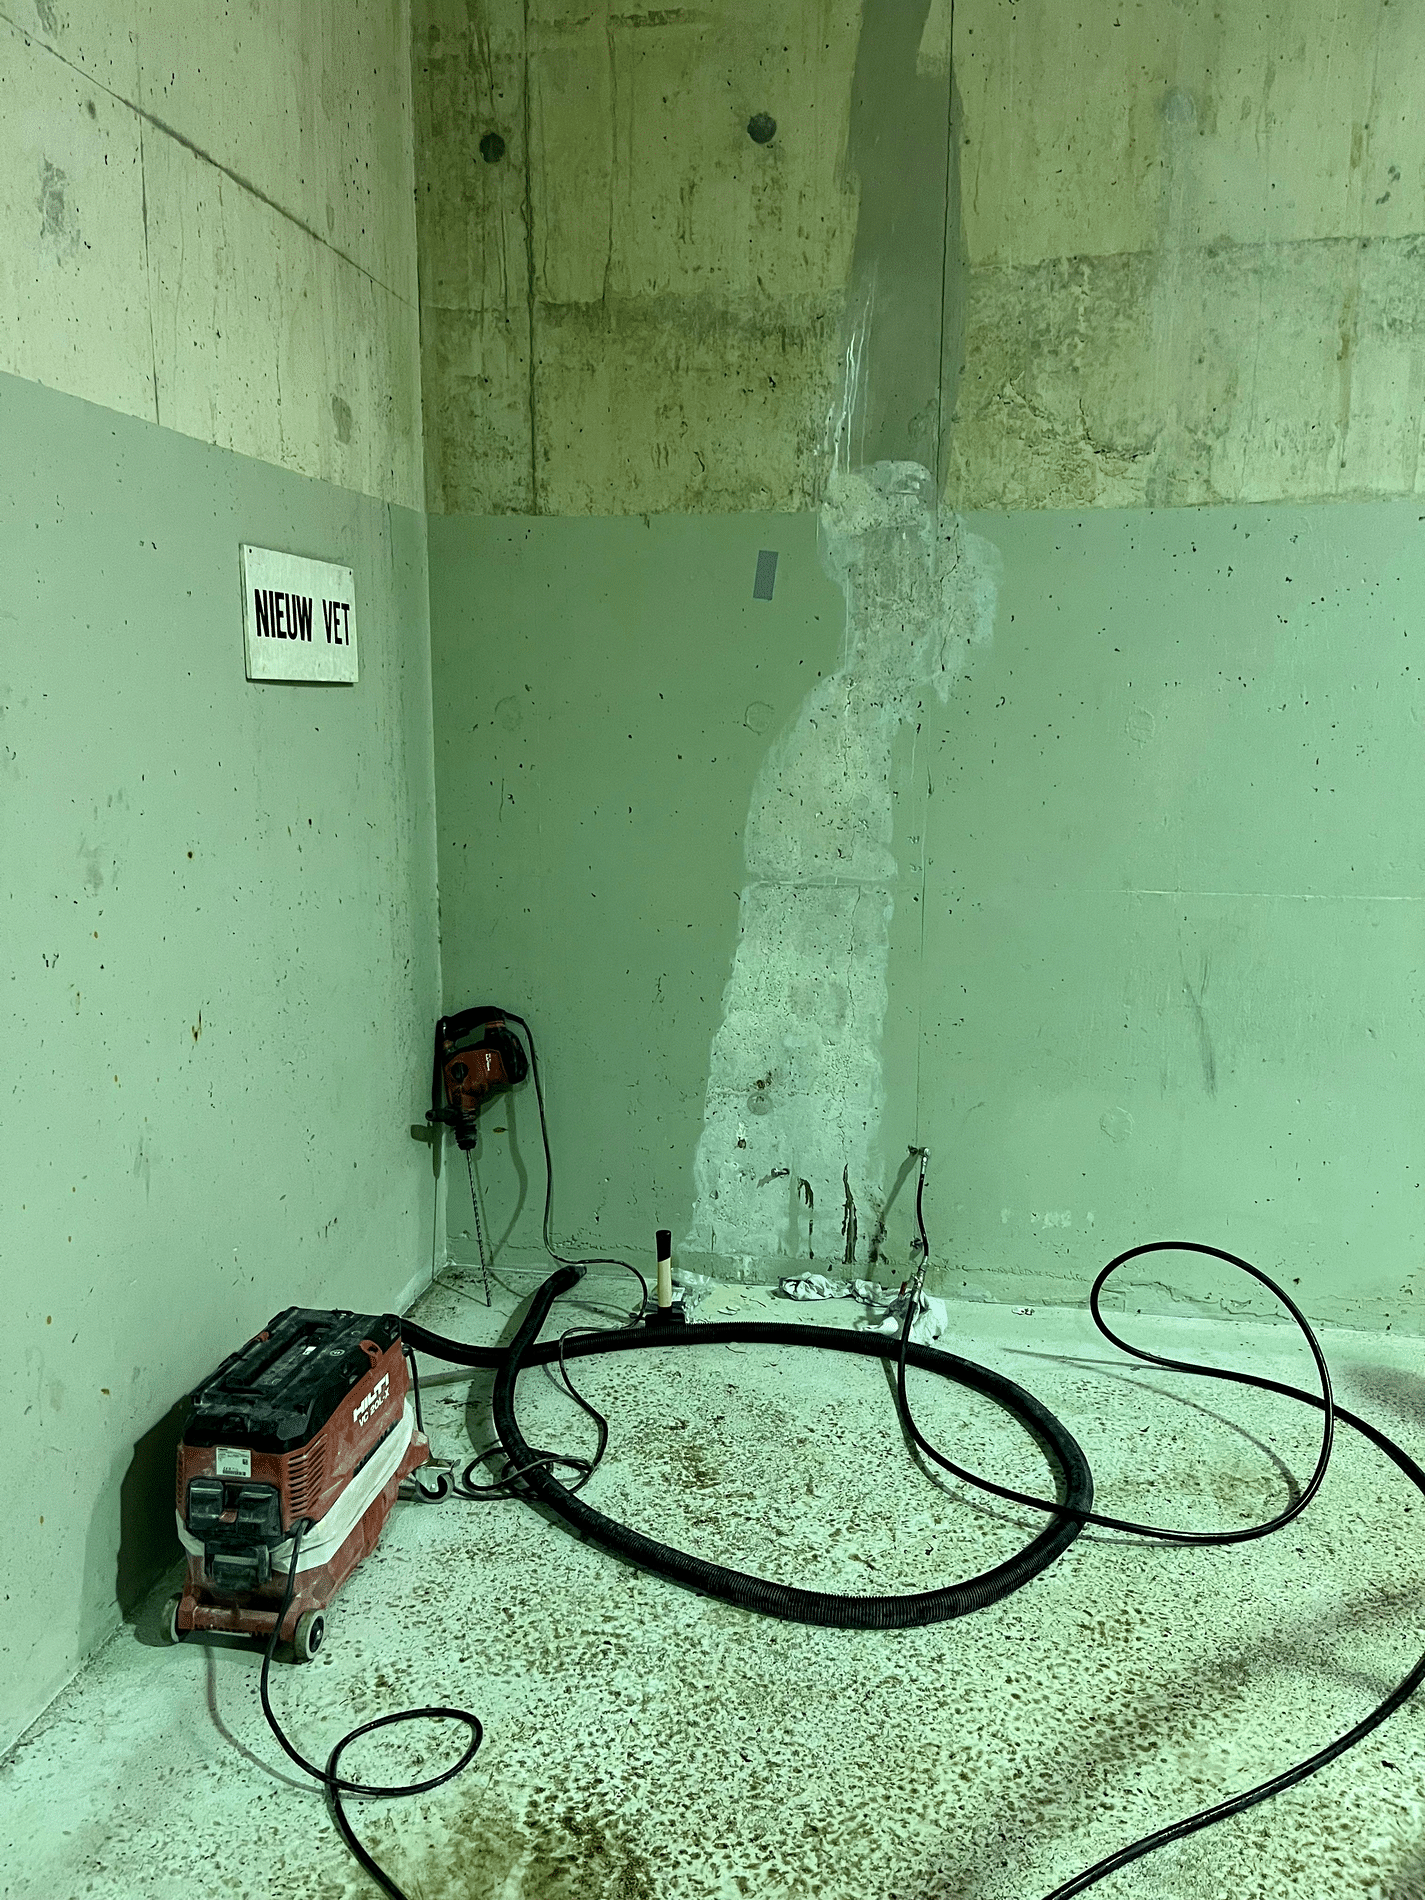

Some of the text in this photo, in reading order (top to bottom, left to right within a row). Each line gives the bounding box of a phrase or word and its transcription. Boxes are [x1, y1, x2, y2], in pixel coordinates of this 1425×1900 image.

[254, 588, 350, 646] NIEUW VET
[353, 1372, 390, 1423] HILTI
[358, 1411, 369, 1427] VC
